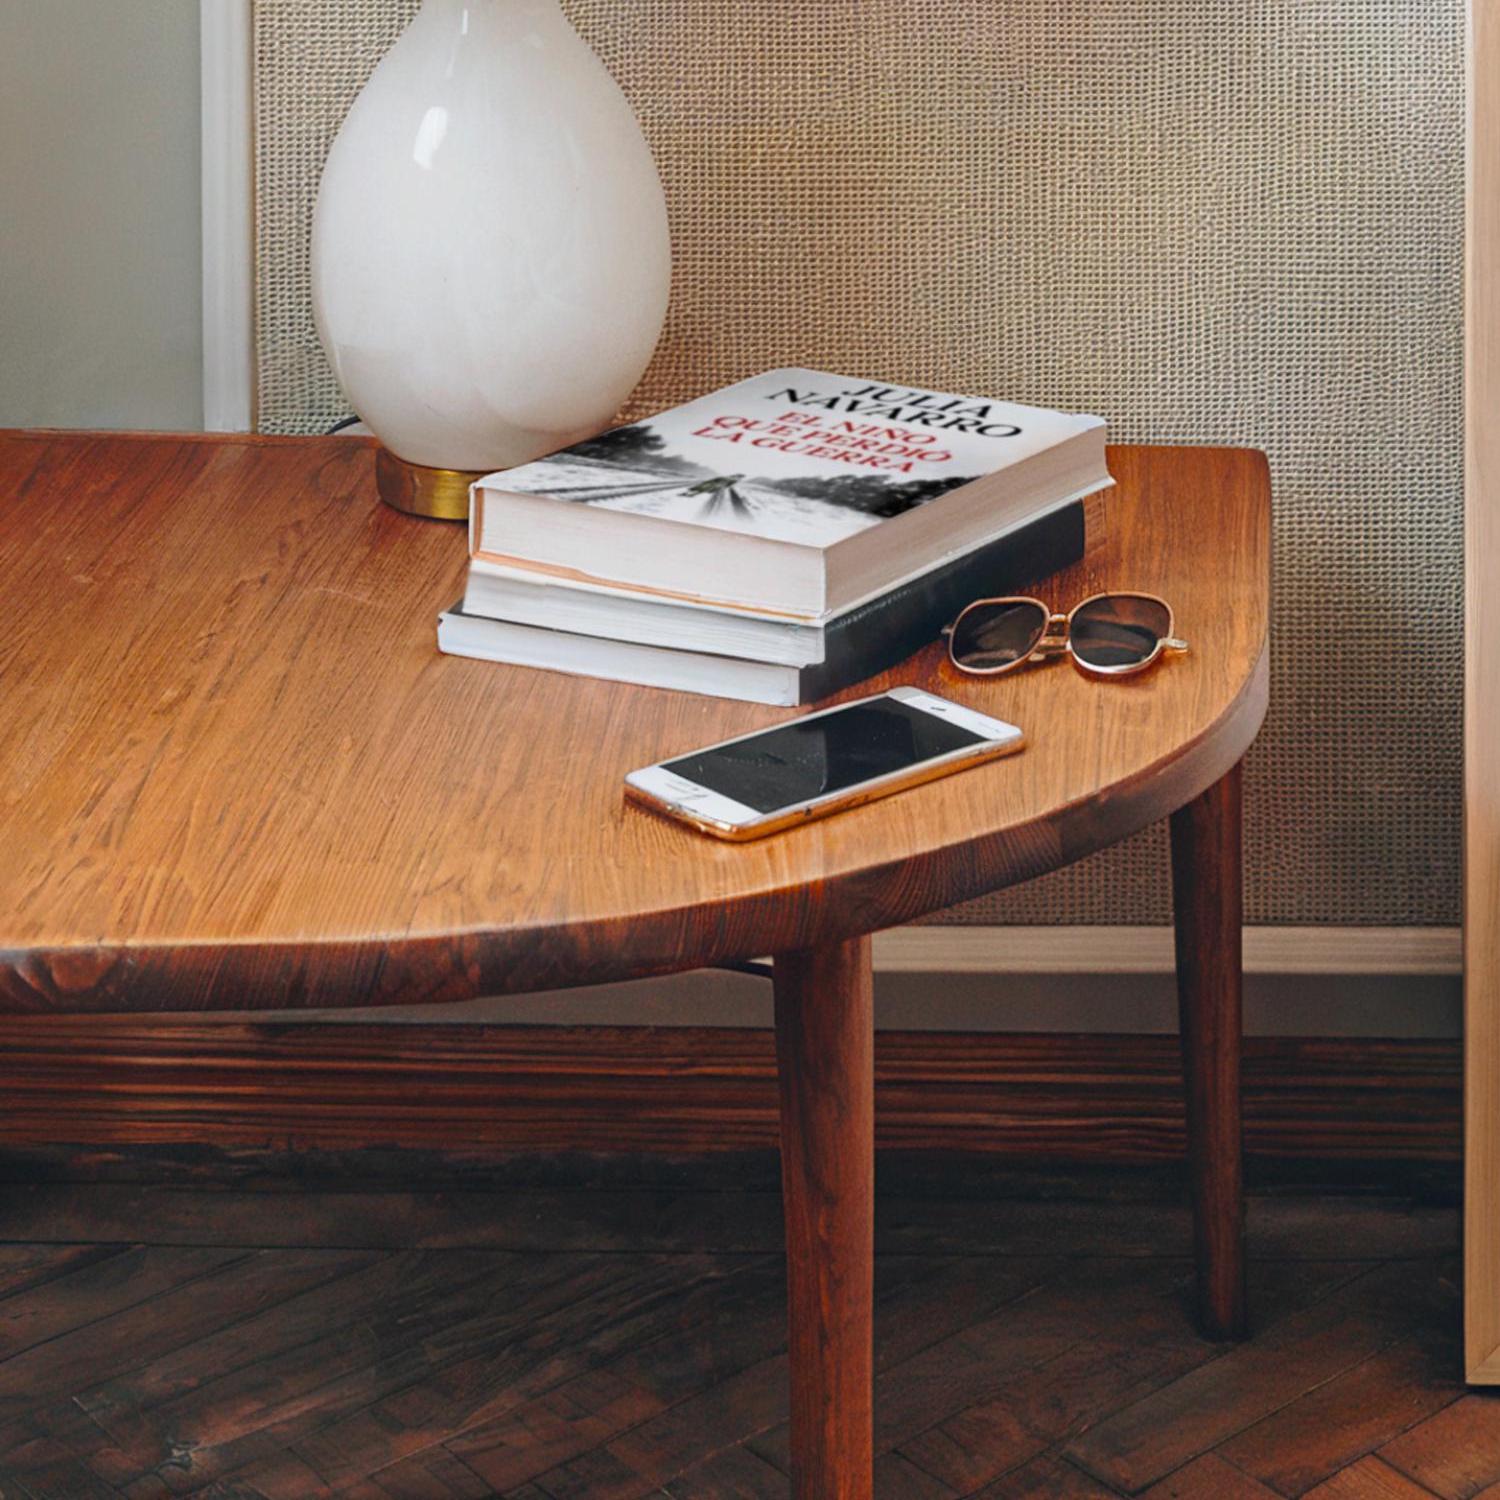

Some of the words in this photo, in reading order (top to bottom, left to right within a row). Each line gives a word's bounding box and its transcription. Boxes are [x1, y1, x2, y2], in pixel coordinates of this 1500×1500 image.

[767, 388, 1023, 438] NAVARRO
[776, 411, 824, 428] EL
[841, 385, 993, 418] JULIA
[690, 425, 745, 444] LA
[750, 436, 916, 474] GUERRA
[712, 415, 802, 438] QUE
[801, 429, 954, 463] PERDIÓ
